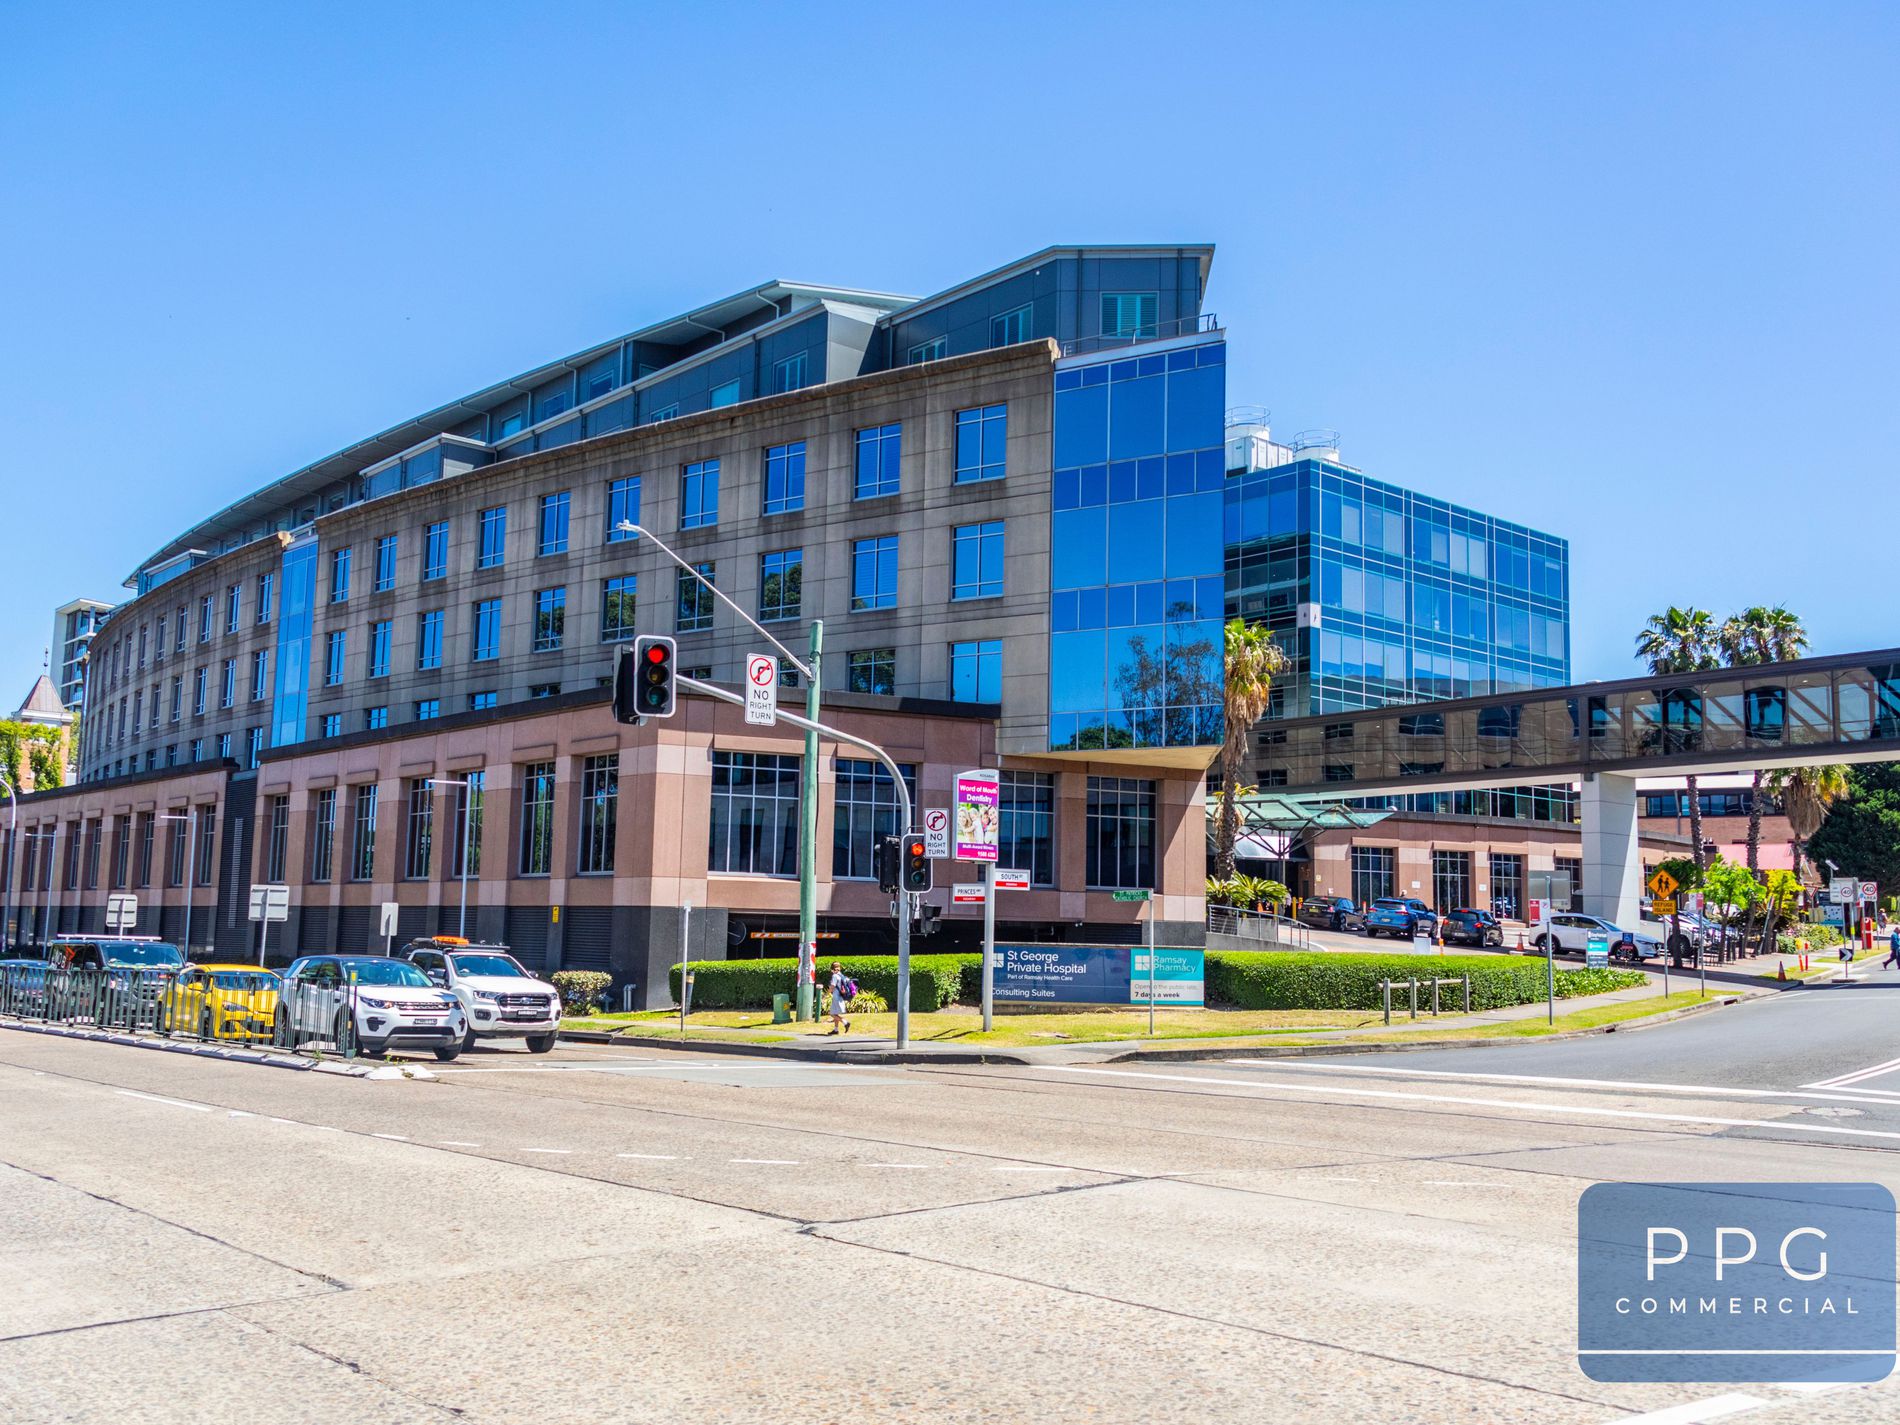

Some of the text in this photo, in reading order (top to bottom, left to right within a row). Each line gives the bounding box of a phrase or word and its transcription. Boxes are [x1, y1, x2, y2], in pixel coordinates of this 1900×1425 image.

[753, 689, 769, 701] NO
[749, 702, 772, 711] RIGHT
[750, 711, 772, 720] TURN
[966, 794, 993, 804] Dentistry
[930, 833, 943, 841] NO
[1864, 885, 1874, 893] 40
[1007, 950, 1059, 963] St George
[1153, 956, 1187, 964] Ramsay
[1007, 962, 1087, 975] Private Hospital
[1153, 964, 1196, 974] Pharmacy
[992, 988, 1056, 998] Consulting Suites
